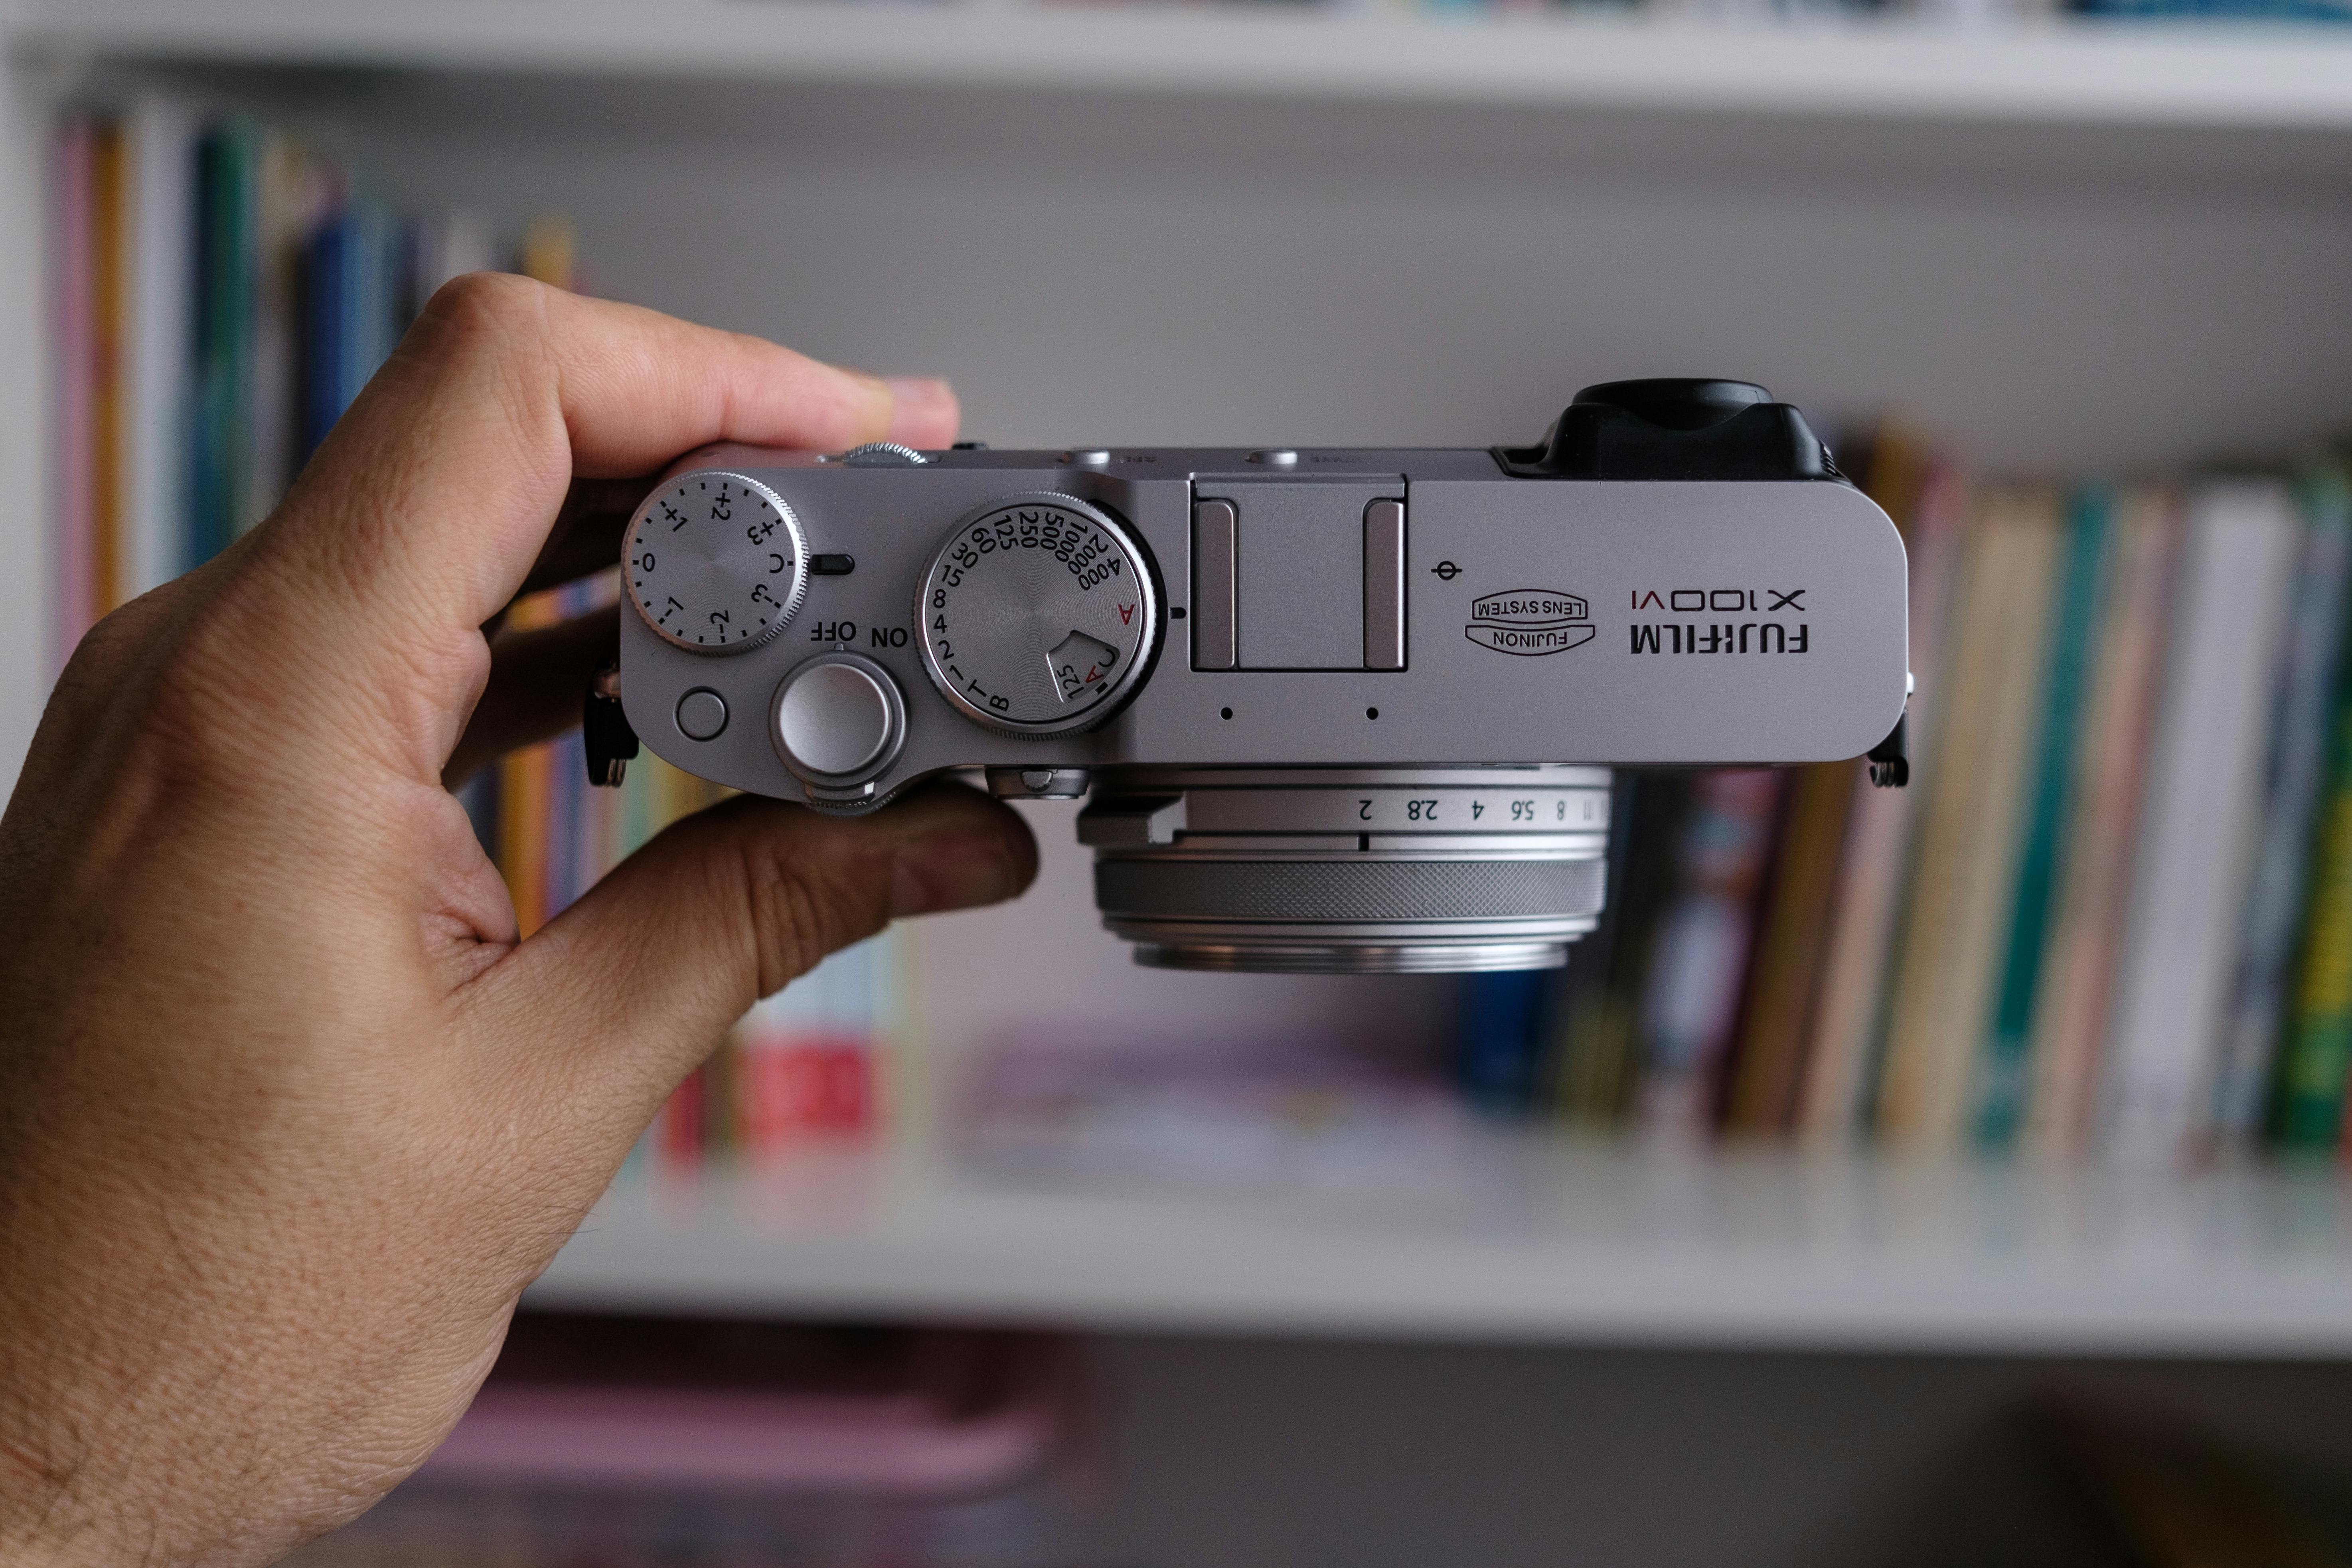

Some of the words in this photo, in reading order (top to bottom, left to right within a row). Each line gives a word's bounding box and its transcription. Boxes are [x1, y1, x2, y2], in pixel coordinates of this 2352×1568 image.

[711, 492, 731, 520] +2
[666, 508, 688, 532] +1
[1019, 511, 1039, 548] 250
[1040, 512, 1064, 549] 500
[747, 521, 774, 545] +3
[972, 527, 996, 553] 60
[993, 515, 1019, 550] 125
[1055, 522, 1088, 562] 1000
[769, 553, 784, 574] C
[952, 542, 978, 569] 30
[1068, 533, 1109, 575] 2000
[941, 565, 964, 587] 15
[1078, 558, 1121, 590] 4000
[933, 589, 946, 608] 8
[1477, 600, 1538, 615] SYSTEM
[1542, 600, 1582, 615] LENS
[933, 614, 947, 633] 4
[1118, 604, 1135, 625] A
[811, 621, 856, 641] OFF
[872, 628, 908, 648] ON
[1493, 630, 1568, 648] FUJINON
[1630, 624, 1808, 654] FUJIFILM
[938, 640, 954, 660] 2
[1098, 648, 1116, 667] C
[949, 665, 964, 680] 1
[1057, 665, 1084, 699] 125
[1085, 665, 1104, 683] A
[967, 679, 987, 697] T
[989, 694, 1009, 712] B
[1359, 800, 1372, 820] 2
[1408, 800, 1438, 821] 2.8
[1471, 800, 1484, 820] 4
[1511, 800, 1534, 821] 5.6
[1557, 801, 1565, 820] 8
